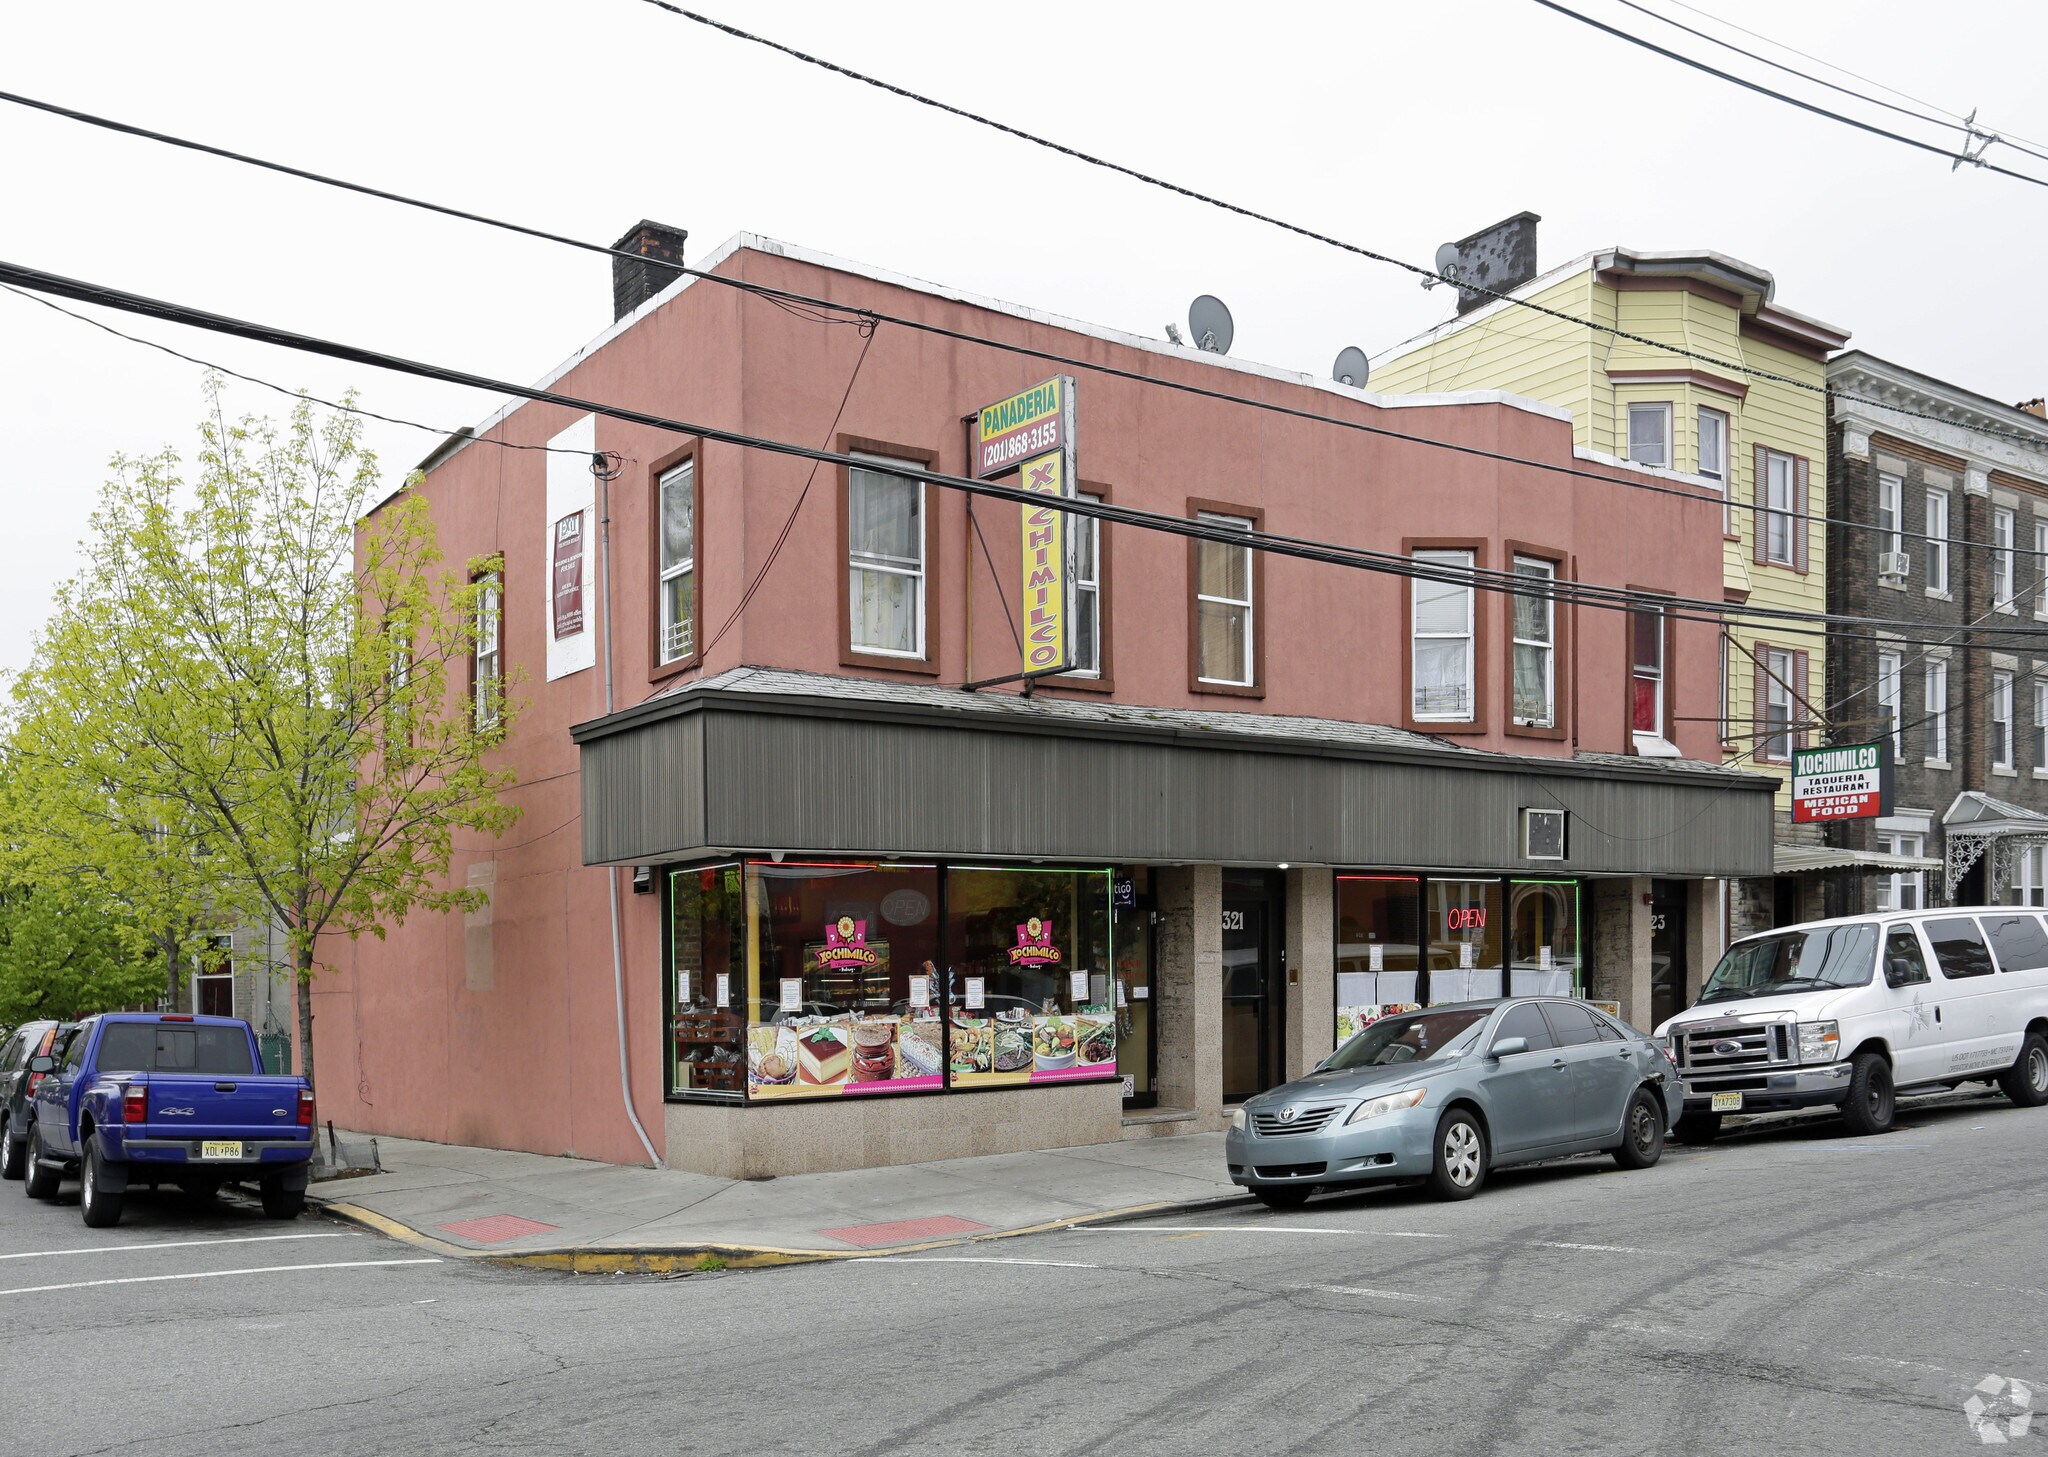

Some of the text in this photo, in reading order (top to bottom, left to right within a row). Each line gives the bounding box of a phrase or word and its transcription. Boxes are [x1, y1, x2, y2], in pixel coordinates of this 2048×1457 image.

[984, 384, 1056, 437] PANADERIA
[984, 421, 1056, 468] (201)868-3155
[560, 516, 578, 536] EXIT
[1027, 462, 1058, 667] XCHIMILCO
[1798, 747, 1876, 775] XOCHIMILCO
[1803, 782, 1871, 795] RESTAURANT
[1809, 774, 1865, 786] TAQUERIA
[1804, 794, 1868, 808] MEXICAN
[1811, 805, 1858, 817] FOOD
[882, 899, 928, 916] OPEN
[1222, 911, 1244, 930] 321
[1448, 908, 1486, 930] OPEN
[819, 948, 875, 963] XOCHIMILCO
[1011, 945, 1059, 960] XOCHIMILCO
